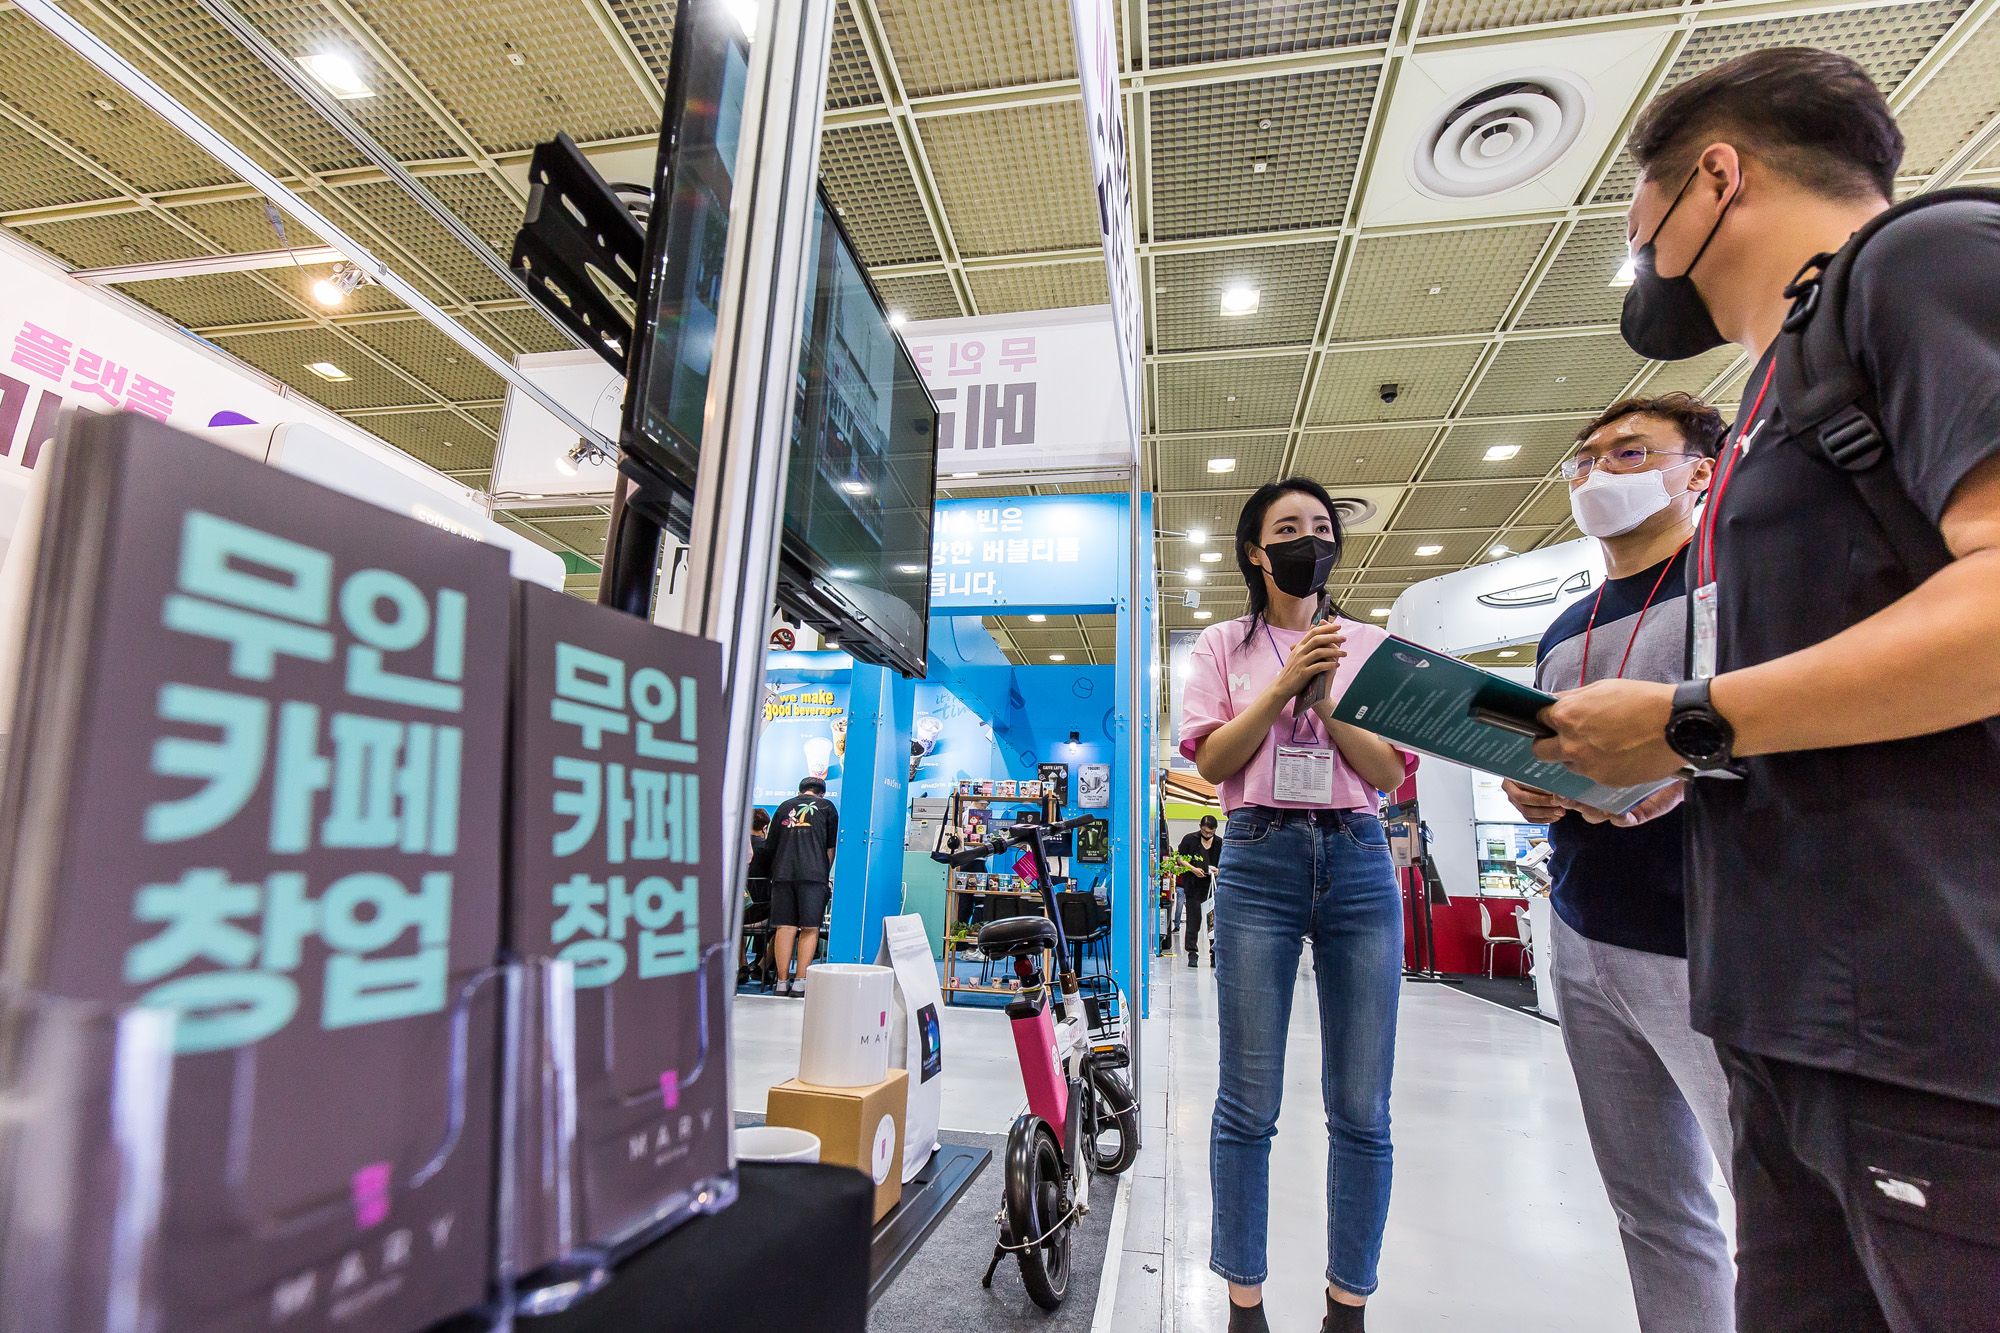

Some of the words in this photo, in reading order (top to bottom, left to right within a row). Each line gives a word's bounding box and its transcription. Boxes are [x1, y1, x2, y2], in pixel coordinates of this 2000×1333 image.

[417, 509, 458, 535] coffee
[982, 537, 1080, 564] 버블티를
[160, 509, 468, 713] 무인
[551, 641, 699, 764] 무인
[765, 704, 793, 721] good
[794, 704, 843, 717] beverages
[779, 693, 798, 704] we
[801, 689, 834, 705] make
[141, 682, 463, 856] 카페
[553, 756, 699, 864] 카페
[123, 867, 453, 1055] 창업
[552, 873, 699, 990] 창업
